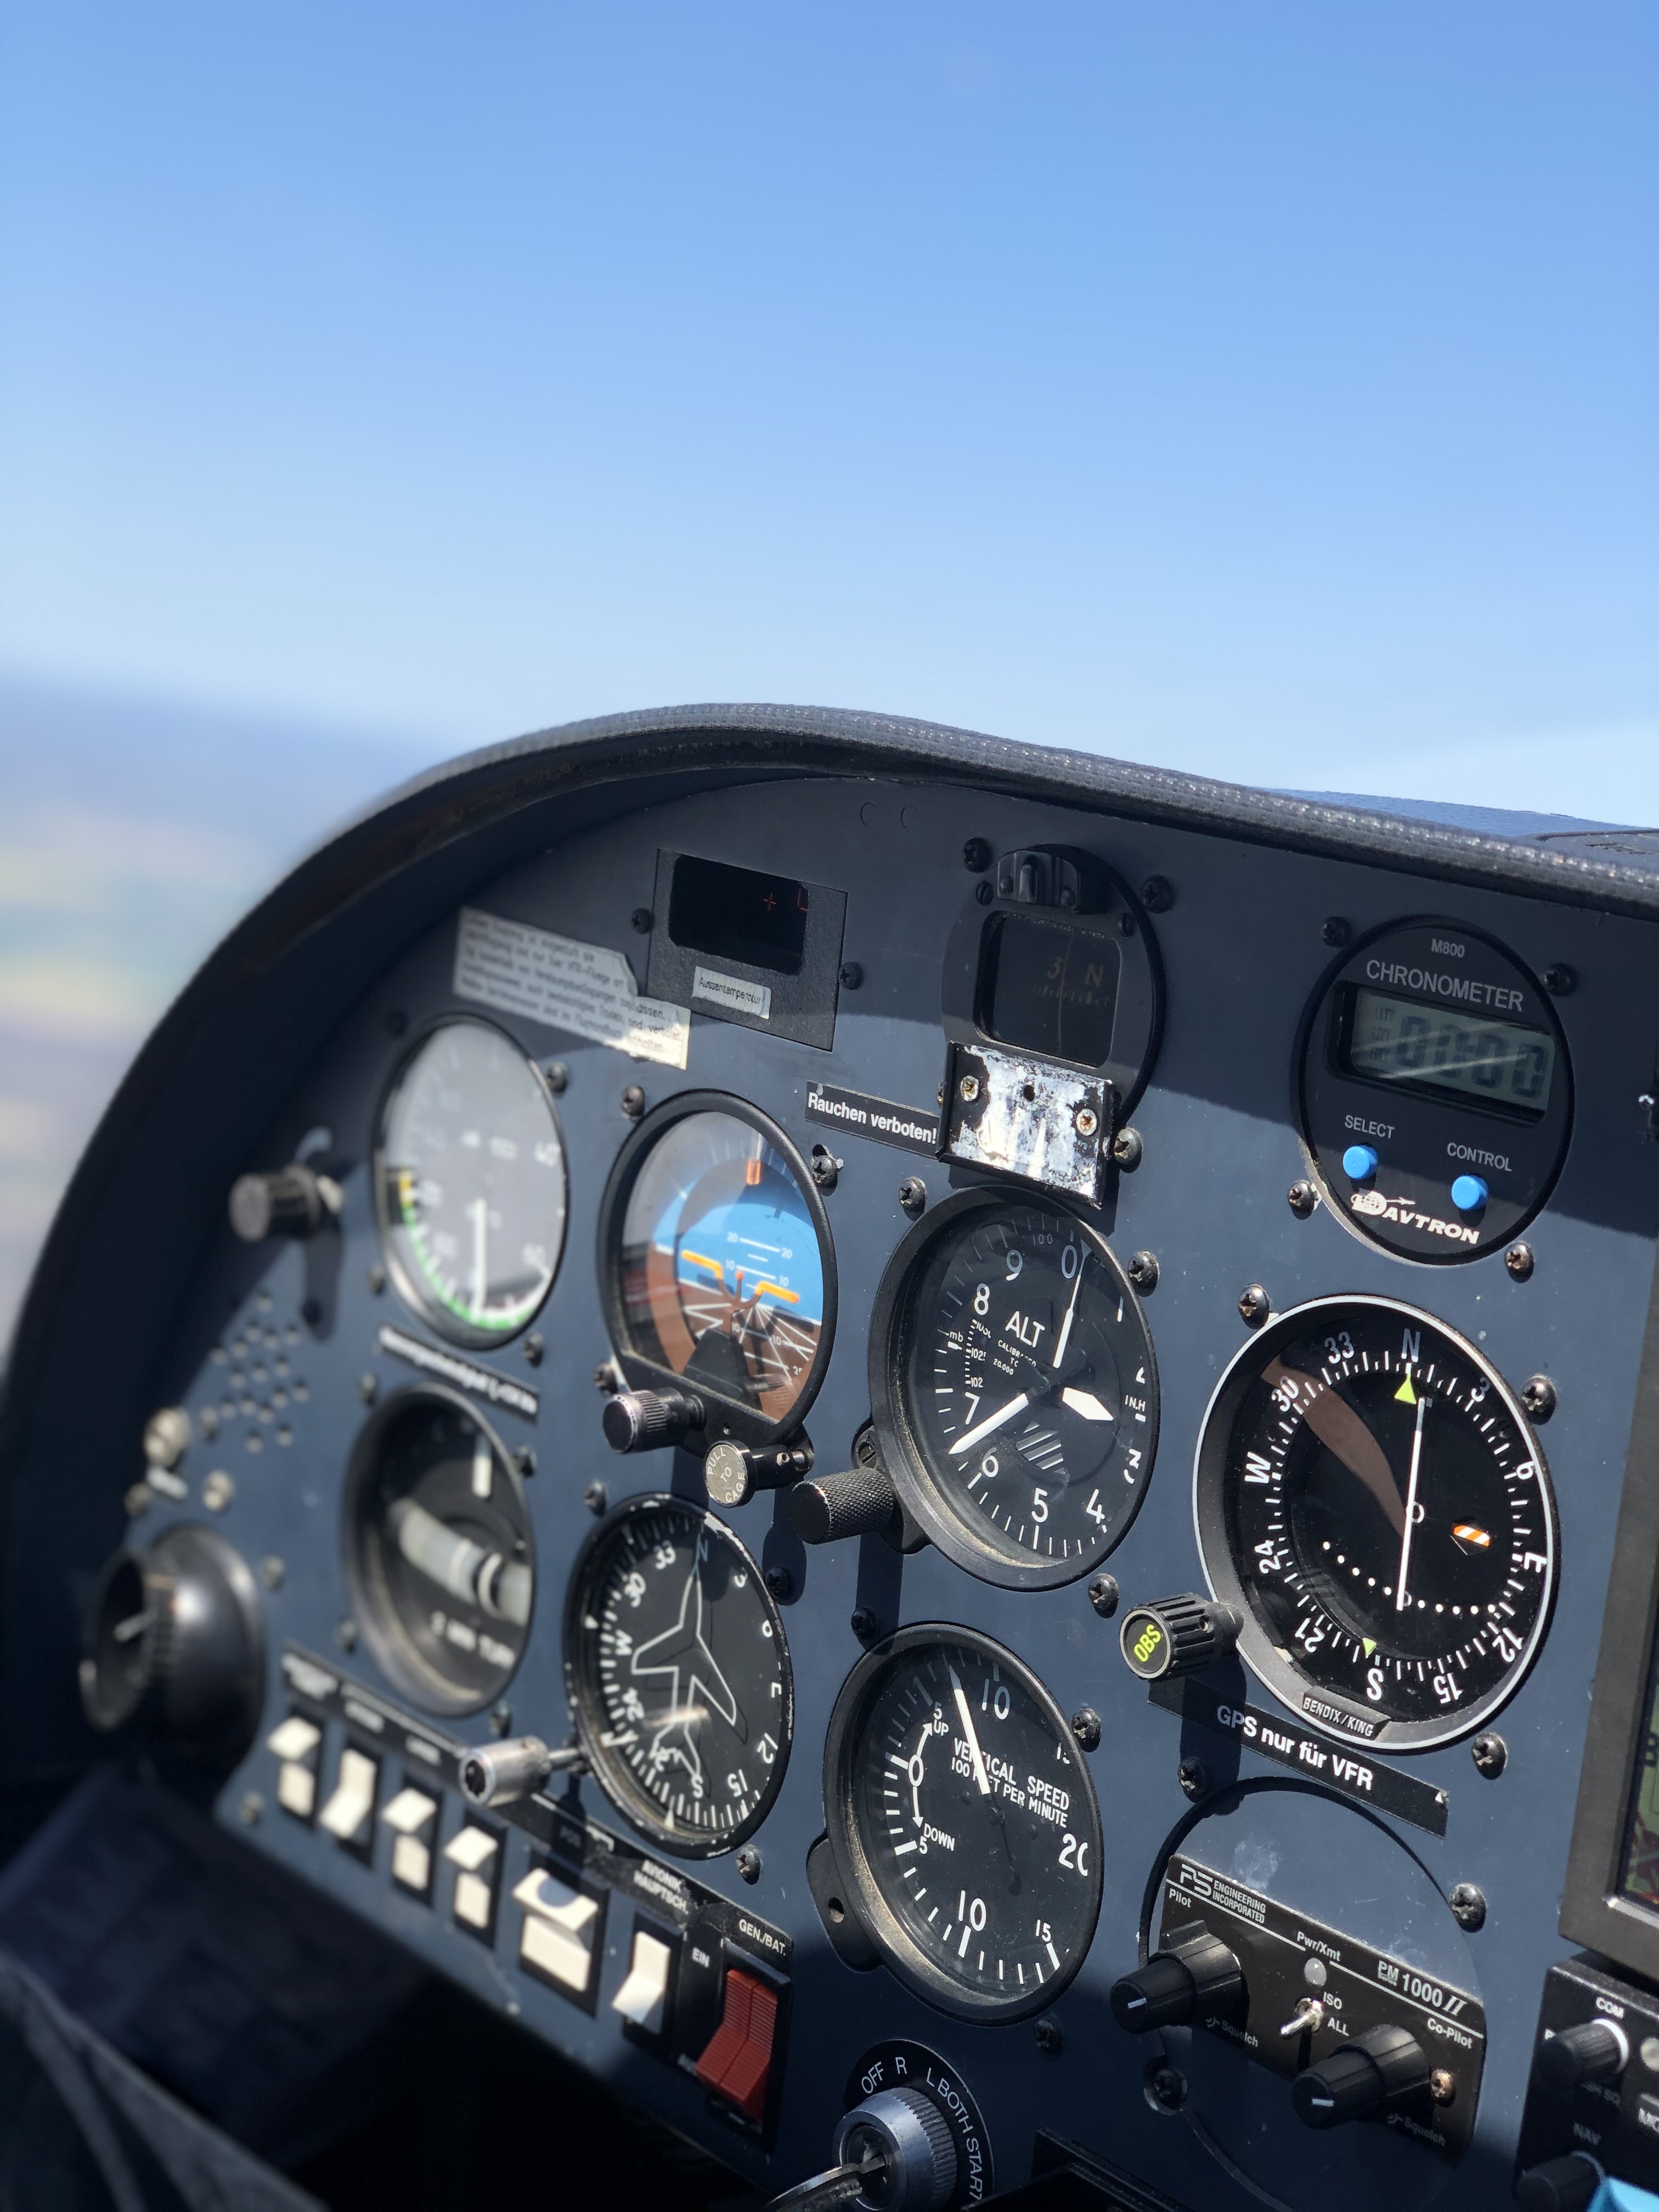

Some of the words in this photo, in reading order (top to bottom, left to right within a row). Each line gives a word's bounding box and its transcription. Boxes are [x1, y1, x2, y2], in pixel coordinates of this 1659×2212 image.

[1431, 939, 1465, 958] M800
[1366, 959, 1523, 1012] CHRONOMETER
[808, 1092, 867, 1124] Rauchen
[871, 1113, 937, 1144] verboten!
[1345, 1114, 1395, 1140] SELECT
[1447, 1142, 1513, 1172] CONTROL
[1351, 1190, 1480, 1245] DAVTRON
[781, 1247, 792, 1259] 20
[1032, 1234, 1053, 1245] 100
[726, 1259, 735, 1270] 10
[1006, 1249, 1023, 1281] 9
[1062, 1245, 1077, 1279] 0
[780, 1276, 789, 1286] 10
[974, 1283, 990, 1316] 8
[950, 1331, 963, 1342] mb
[1005, 1311, 1045, 1348] ALT
[1401, 1328, 1421, 1363] N
[1324, 1331, 1355, 1364] 33
[1271, 1375, 1300, 1414] 30
[1471, 1377, 1492, 1402] 3
[964, 1391, 980, 1425] 7
[707, 1447, 727, 1476] PULL
[720, 1466, 732, 1483] TO
[981, 1447, 999, 1478] 6
[1244, 1451, 1272, 1485] W
[725, 1471, 746, 1503] CAGE
[1031, 1487, 1048, 1523] 5
[1086, 1488, 1105, 1524] 4
[653, 1539, 676, 1570] 33
[1254, 1540, 1280, 1575] 24
[1133, 1623, 1162, 1663] OBS
[1295, 1627, 1322, 1654] 21
[1492, 1626, 1525, 1664] 12
[982, 1678, 1011, 1720] 10
[1366, 1667, 1385, 1702] S
[1433, 1673, 1464, 1705] 15
[933, 1701, 943, 1720] 5
[934, 1719, 950, 1736] UP
[757, 1732, 778, 1764] 12
[1216, 1705, 1258, 1738] GPS
[1261, 1727, 1296, 1754] nur
[1299, 1741, 1327, 1769] für
[1331, 1753, 1373, 1791] VFR
[727, 1768, 749, 1798] 15
[909, 1754, 924, 1787] 0
[951, 1757, 970, 1778] 100
[1003, 1782, 1025, 1807] PER
[1028, 1796, 1069, 1829] MINUTE
[1026, 1775, 1070, 1811] SPEED
[919, 1836, 928, 1854] 5
[924, 1822, 955, 1852] DOWN
[1180, 1864, 1214, 1897] PS
[958, 1890, 987, 1932] 10
[1169, 1887, 1192, 1909] Pilot
[1212, 1891, 1265, 1925] INCORPORATED
[1214, 1880, 1266, 1914] ENGINEERING
[738, 1919, 786, 1956] GEN./BAT.
[1035, 1919, 1051, 1942] 15
[1296, 1931, 1341, 1962] Pwr/Xmt
[691, 1947, 710, 1968] EIN
[1323, 1991, 1342, 2010] ISO
[1378, 1960, 1399, 1982] PM
[1402, 1973, 1443, 2008] 1000
[1442, 1995, 1468, 2017] II
[1595, 1996, 1624, 2019] COM
[1221, 2020, 1259, 2048] Squelch
[1327, 2017, 1350, 2037] ALL
[1427, 2018, 1474, 2049] Co-Pilot
[861, 2061, 884, 2094] OFF
[895, 2056, 908, 2075] R
[926, 2067, 935, 2087] L
[937, 2077, 973, 2134] BOTH
